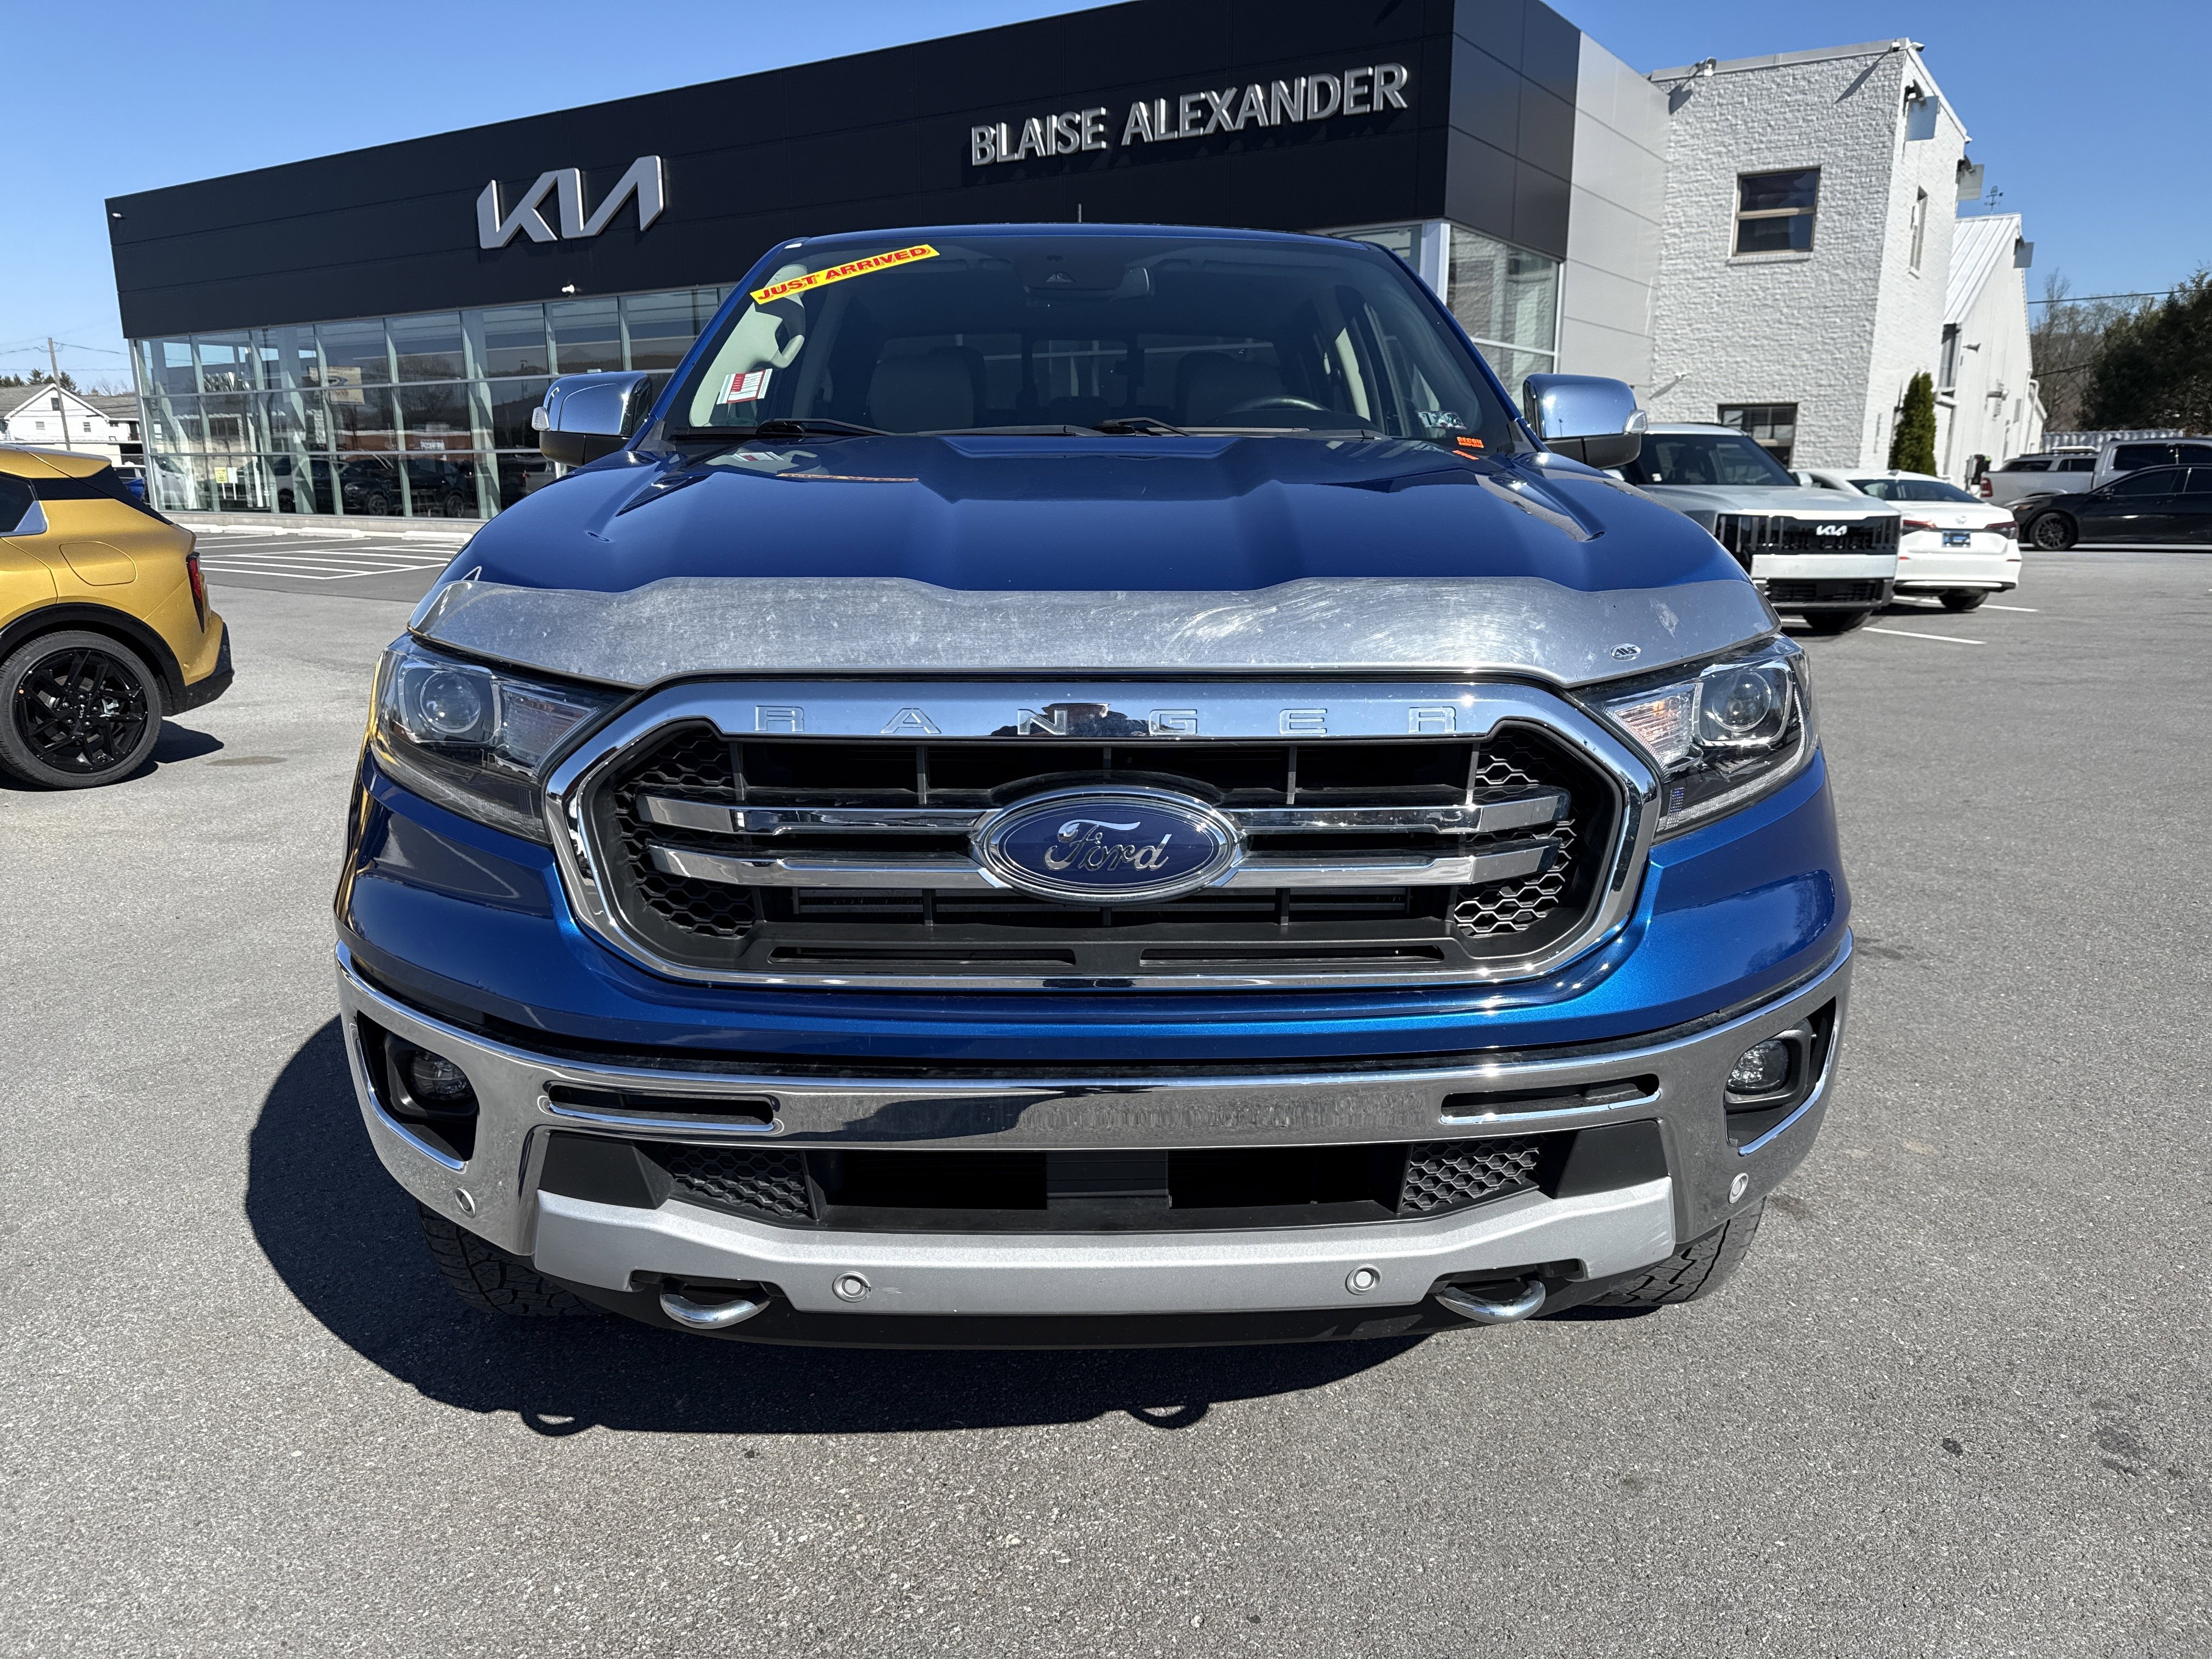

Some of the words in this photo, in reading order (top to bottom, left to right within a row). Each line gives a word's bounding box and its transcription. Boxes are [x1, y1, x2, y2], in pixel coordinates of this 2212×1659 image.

[972, 106, 1107, 166] BLAISE
[1121, 62, 1408, 145] ALEXANDER
[476, 155, 664, 249] KIA
[758, 275, 817, 300] JUST
[825, 247, 931, 280] ARRIVED
[755, 705, 1457, 735] RANGER
[1044, 819, 1172, 871] Ford
